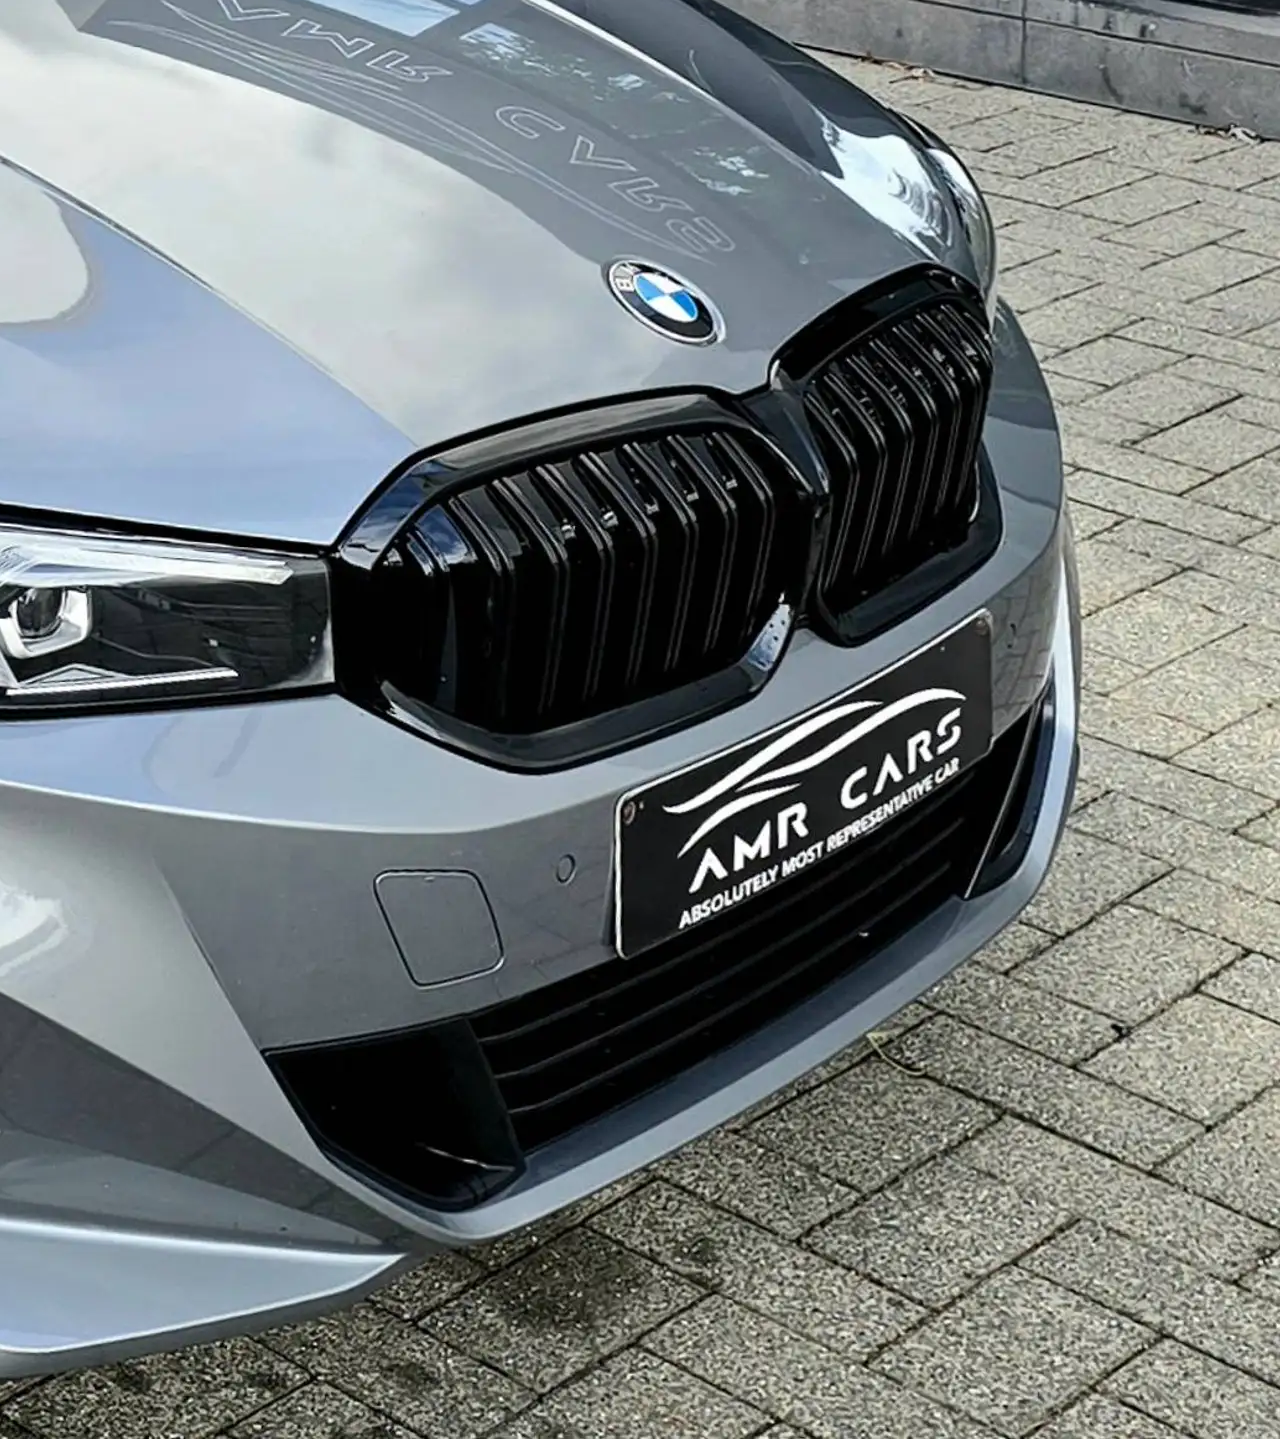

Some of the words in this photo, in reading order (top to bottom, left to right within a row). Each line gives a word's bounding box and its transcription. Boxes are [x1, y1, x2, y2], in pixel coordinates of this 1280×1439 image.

[678, 866, 780, 930] ABSOLUTELY
[781, 840, 824, 877] MOST
[826, 778, 933, 853] REPRESENTATIVE
[934, 757, 960, 793] CAR
[689, 802, 809, 893] AMR
[841, 707, 961, 809] CARS
